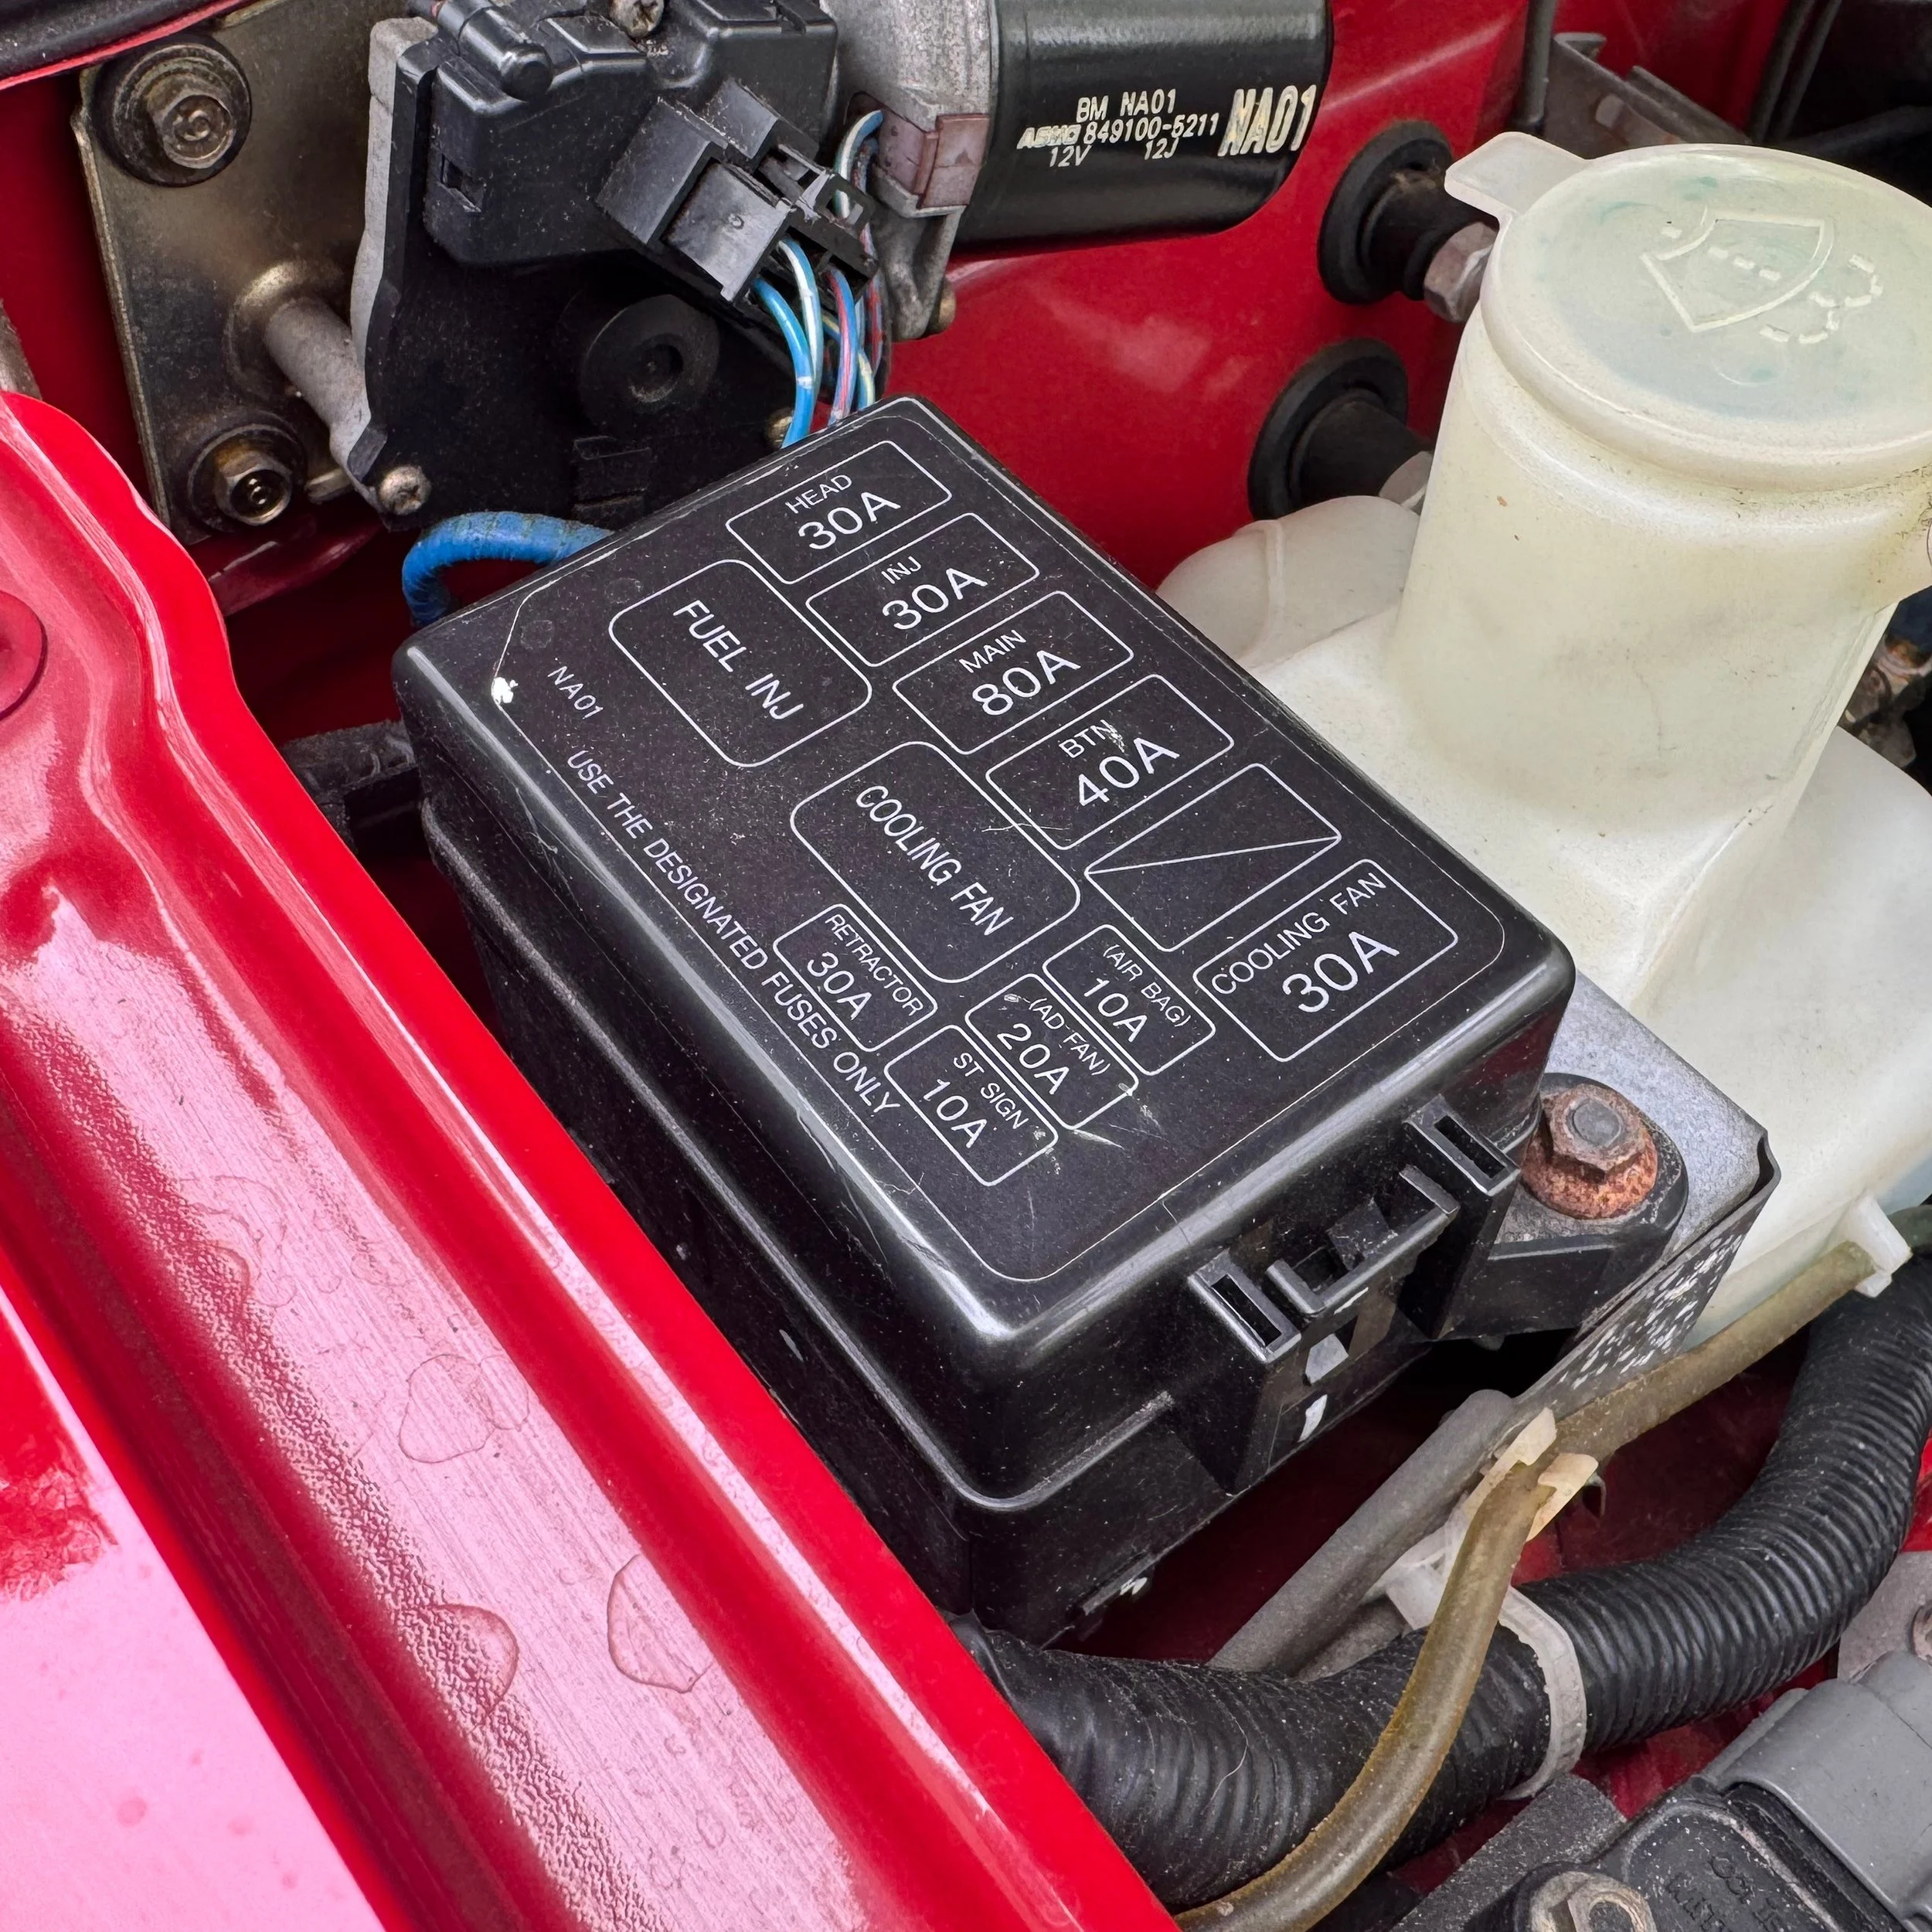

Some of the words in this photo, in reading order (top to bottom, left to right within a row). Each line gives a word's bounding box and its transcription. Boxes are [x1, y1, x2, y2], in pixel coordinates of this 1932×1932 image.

[1077, 96, 1109, 123] BM
[1120, 88, 1176, 117] NA01
[1083, 113, 1219, 146] 849100-5211
[1217, 84, 1317, 157] NA01
[1049, 145, 1092, 167] 12V
[1144, 138, 1180, 161] 12J
[785, 474, 852, 513] HEAD
[798, 491, 901, 550] 30A
[881, 556, 922, 584] INJ
[882, 567, 988, 630] 30A
[673, 600, 747, 672] FUEL
[745, 673, 804, 719] INJ
[958, 629, 1026, 673] MAIN
[972, 649, 1081, 716] 80A
[547, 665, 603, 719] NA01
[1058, 719, 1119, 758] BTN
[1078, 737, 1180, 806] 40A
[855, 785, 961, 886] COOLING
[951, 882, 1014, 936] FAN
[567, 750, 614, 794] USE
[607, 792, 653, 838] THE
[643, 838, 769, 971] DESIGNATED
[762, 971, 838, 1049] FUSES
[833, 1052, 901, 1114] ONLY
[825, 913, 923, 1017] RETRACTOR
[1211, 912, 1331, 995] COOLING
[1329, 872, 1386, 914] FAN
[807, 951, 872, 1020] 30A
[1103, 944, 1143, 981] (AIR
[1141, 982, 1192, 1027] BAG)
[1282, 931, 1400, 1012] 30A
[1083, 978, 1148, 1042] 10A
[997, 1023, 1070, 1094] 20A
[1063, 1032, 1111, 1075] FAN)
[923, 1079, 988, 1148] 10A
[953, 1053, 985, 1077] ST
[980, 1083, 1029, 1129] SIGN
